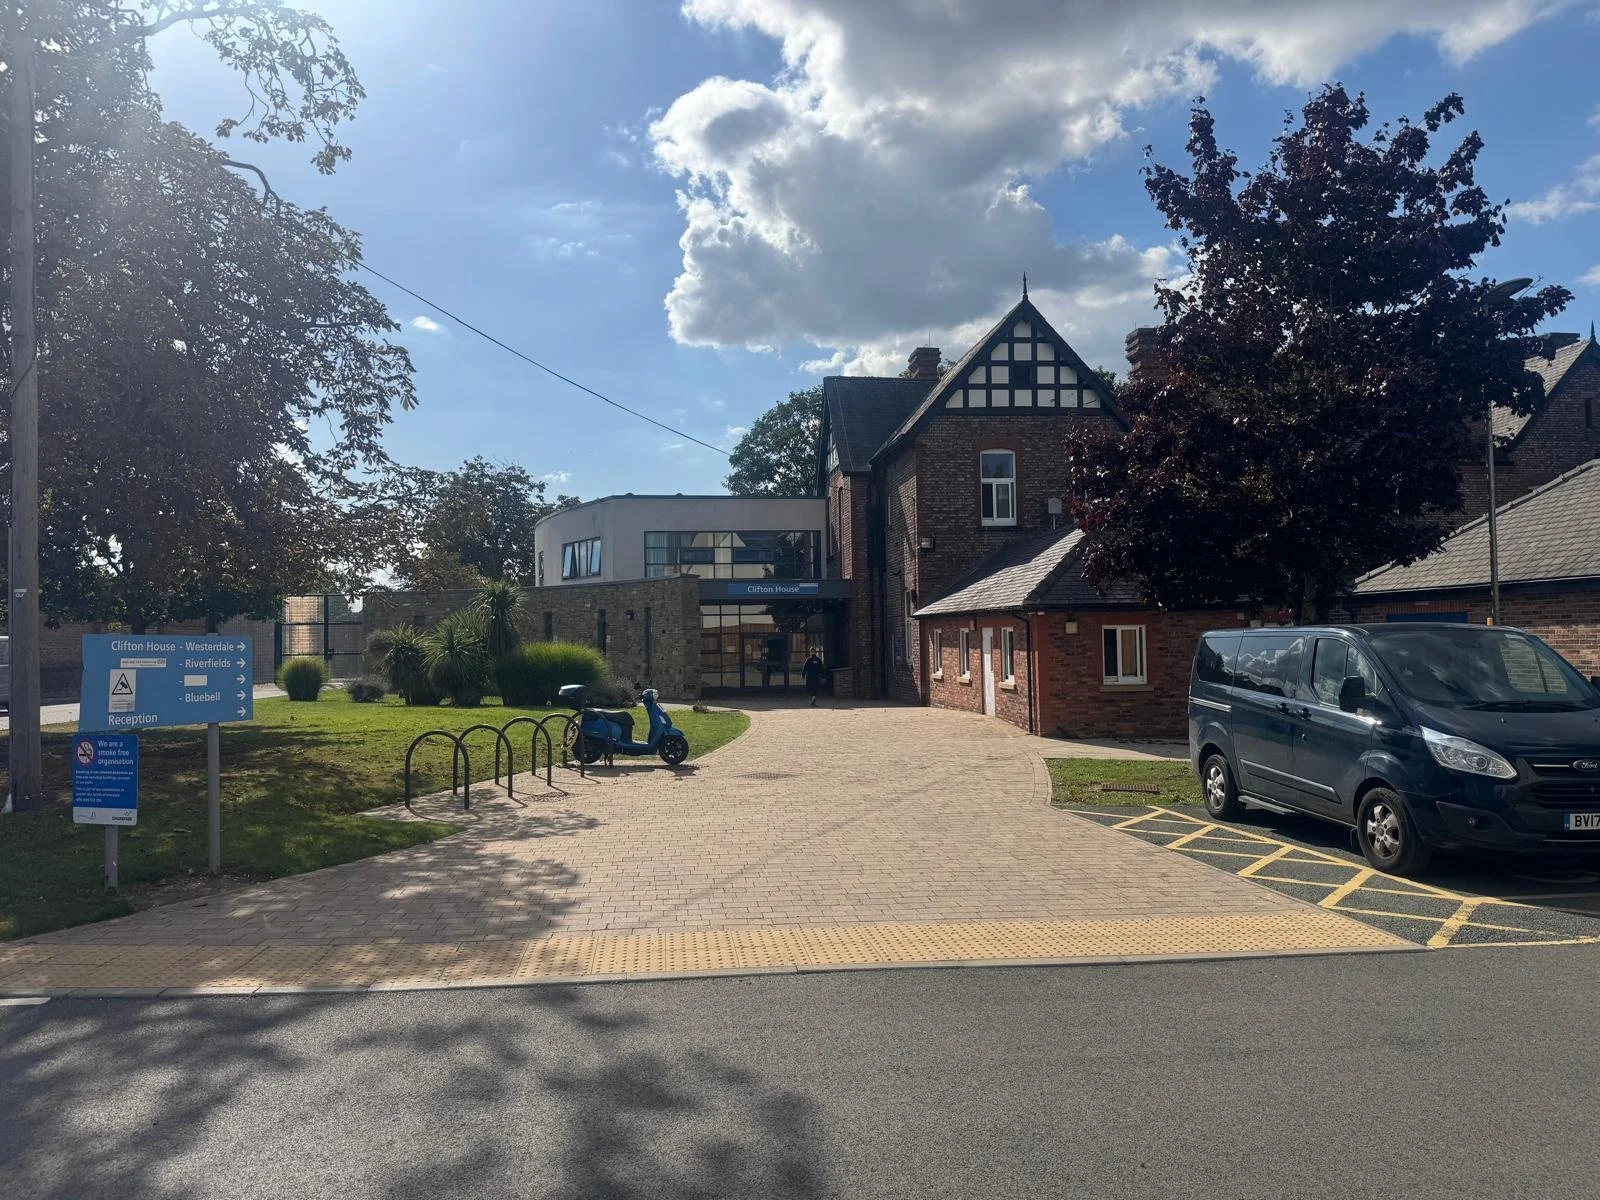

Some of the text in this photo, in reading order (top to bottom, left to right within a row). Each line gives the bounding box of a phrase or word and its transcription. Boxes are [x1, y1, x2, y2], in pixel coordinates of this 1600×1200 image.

[747, 585, 800, 593] Clifton House
[111, 640, 144, 652] Clifton
[146, 641, 176, 652] House
[185, 641, 234, 652] Westerdale
[185, 658, 231, 669] Riverfields
[185, 691, 221, 702] Bluebell
[108, 712, 158, 727] Reception
[97, 740, 108, 748] We
[97, 758, 134, 767] organisation
[1581, 761, 1598, 769] Ford
